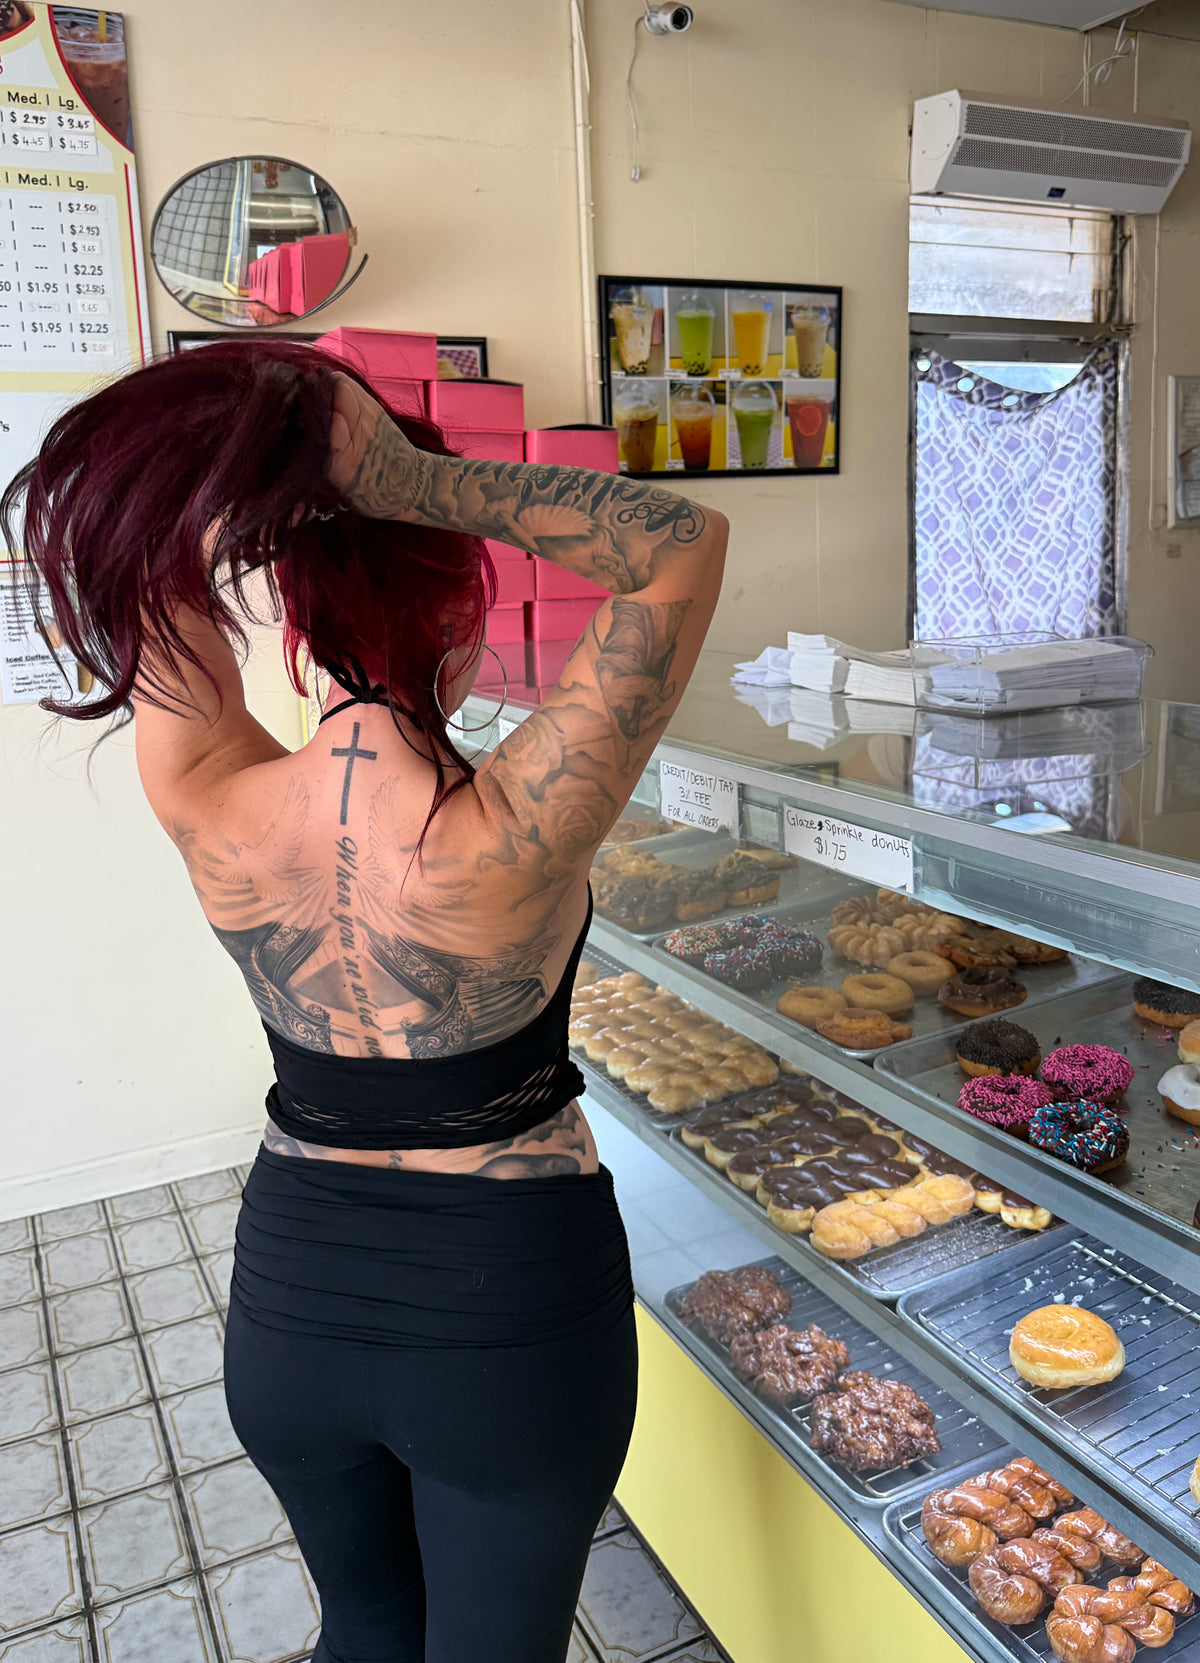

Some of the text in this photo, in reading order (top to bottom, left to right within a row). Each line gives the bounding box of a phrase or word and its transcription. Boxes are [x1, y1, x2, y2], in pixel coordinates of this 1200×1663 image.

[7, 91, 79, 111] Med. Lg.
[18, 173, 89, 192] Med. Lg.
[74, 264, 104, 276] $2.25
[27, 281, 59, 294] $1.95
[31, 321, 109, 334] $1.95 $2.25
[694, 791, 712, 806] FEE
[667, 804, 720, 830] FOR ALL ORDERS
[786, 809, 817, 830] Glaze
[823, 819, 864, 843] Sprinkle
[871, 834, 911, 858] donuts
[813, 836, 848, 861] $1.75
[335, 836, 360, 907] When
[328, 906, 362, 980] you're
[351, 981, 383, 1032] solid
